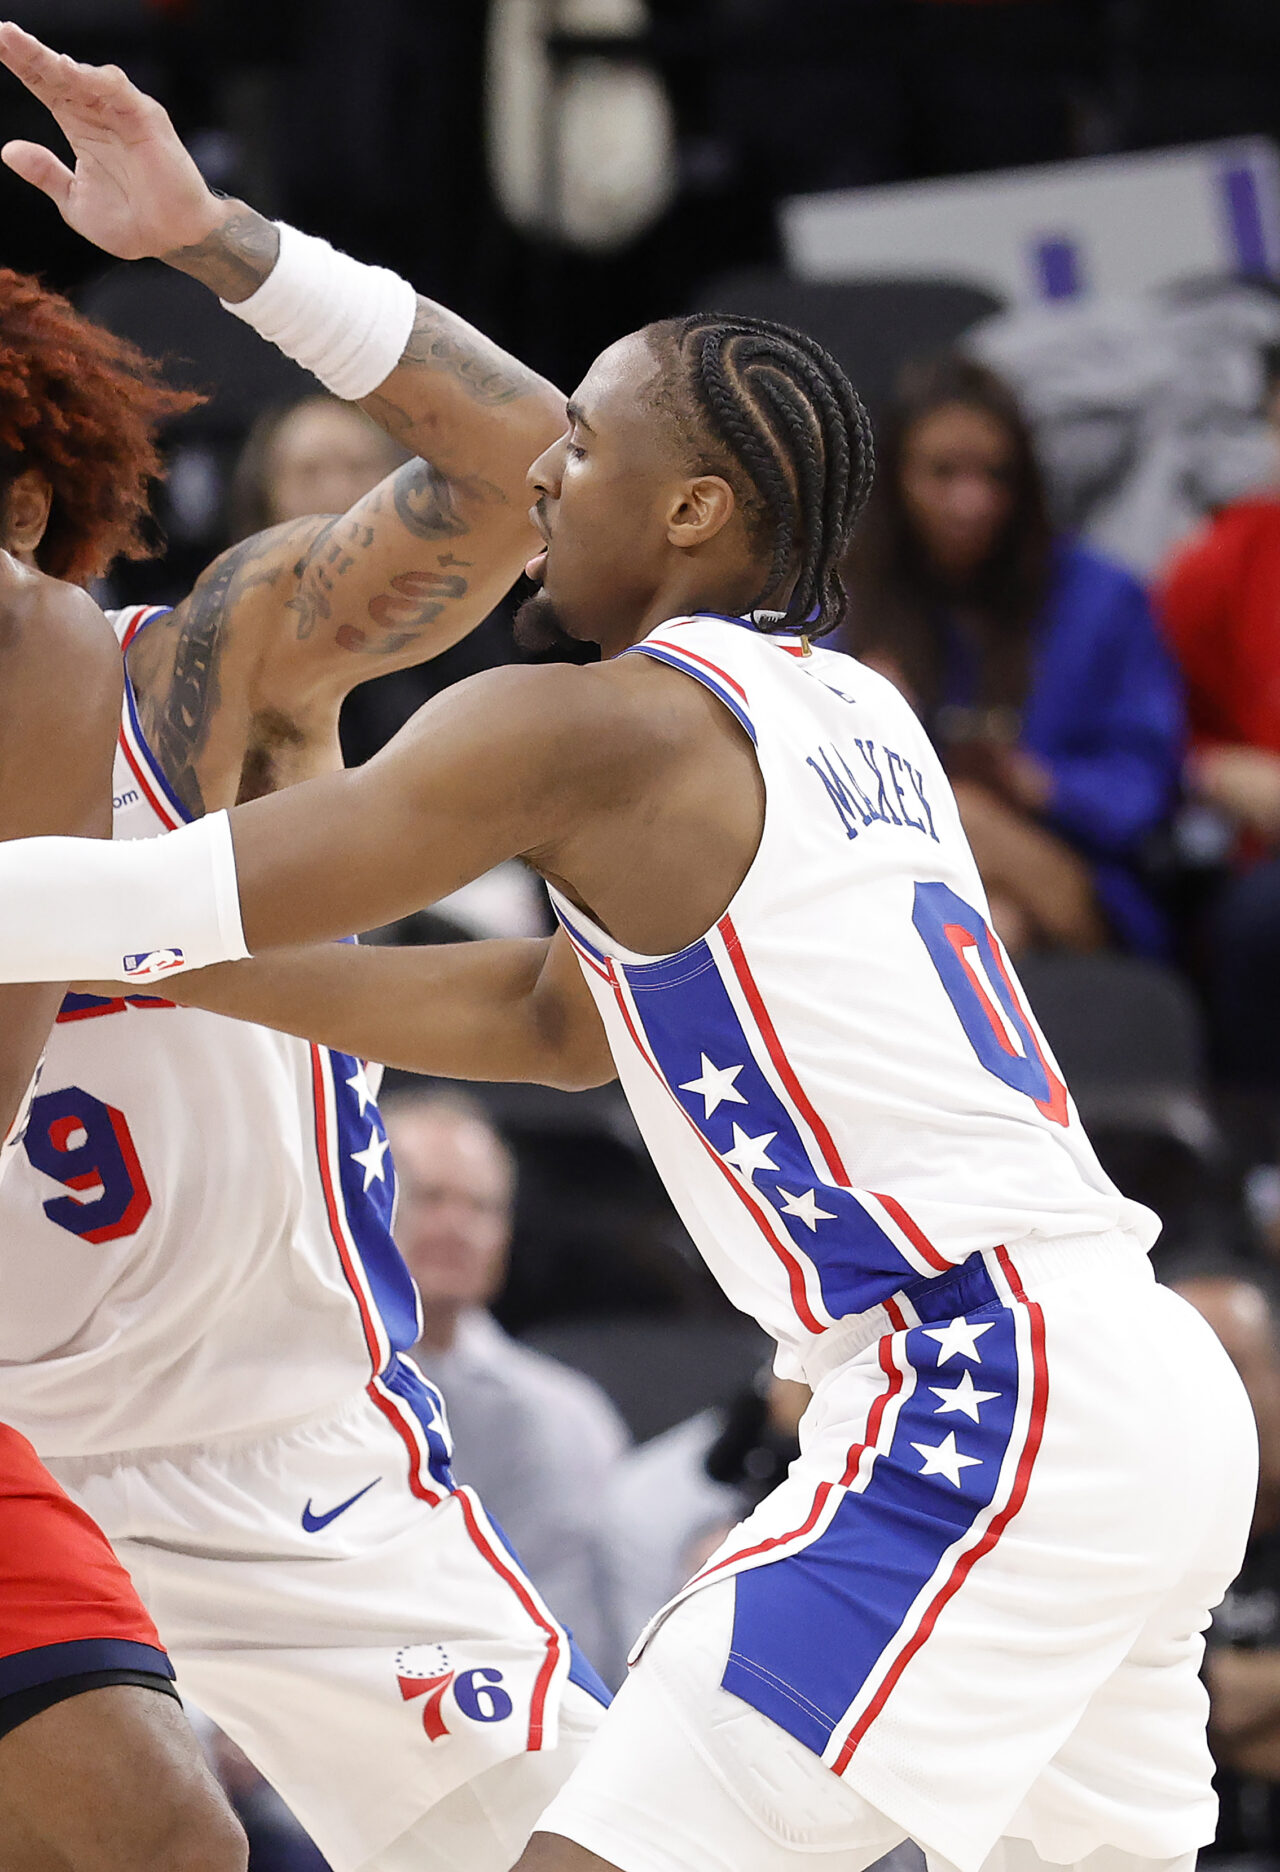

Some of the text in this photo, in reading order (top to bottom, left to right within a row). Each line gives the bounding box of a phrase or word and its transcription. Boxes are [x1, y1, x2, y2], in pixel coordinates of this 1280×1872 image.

[911, 881, 1070, 1128] 0
[23, 1086, 152, 1245] 9
[396, 1667, 513, 1743] 76
